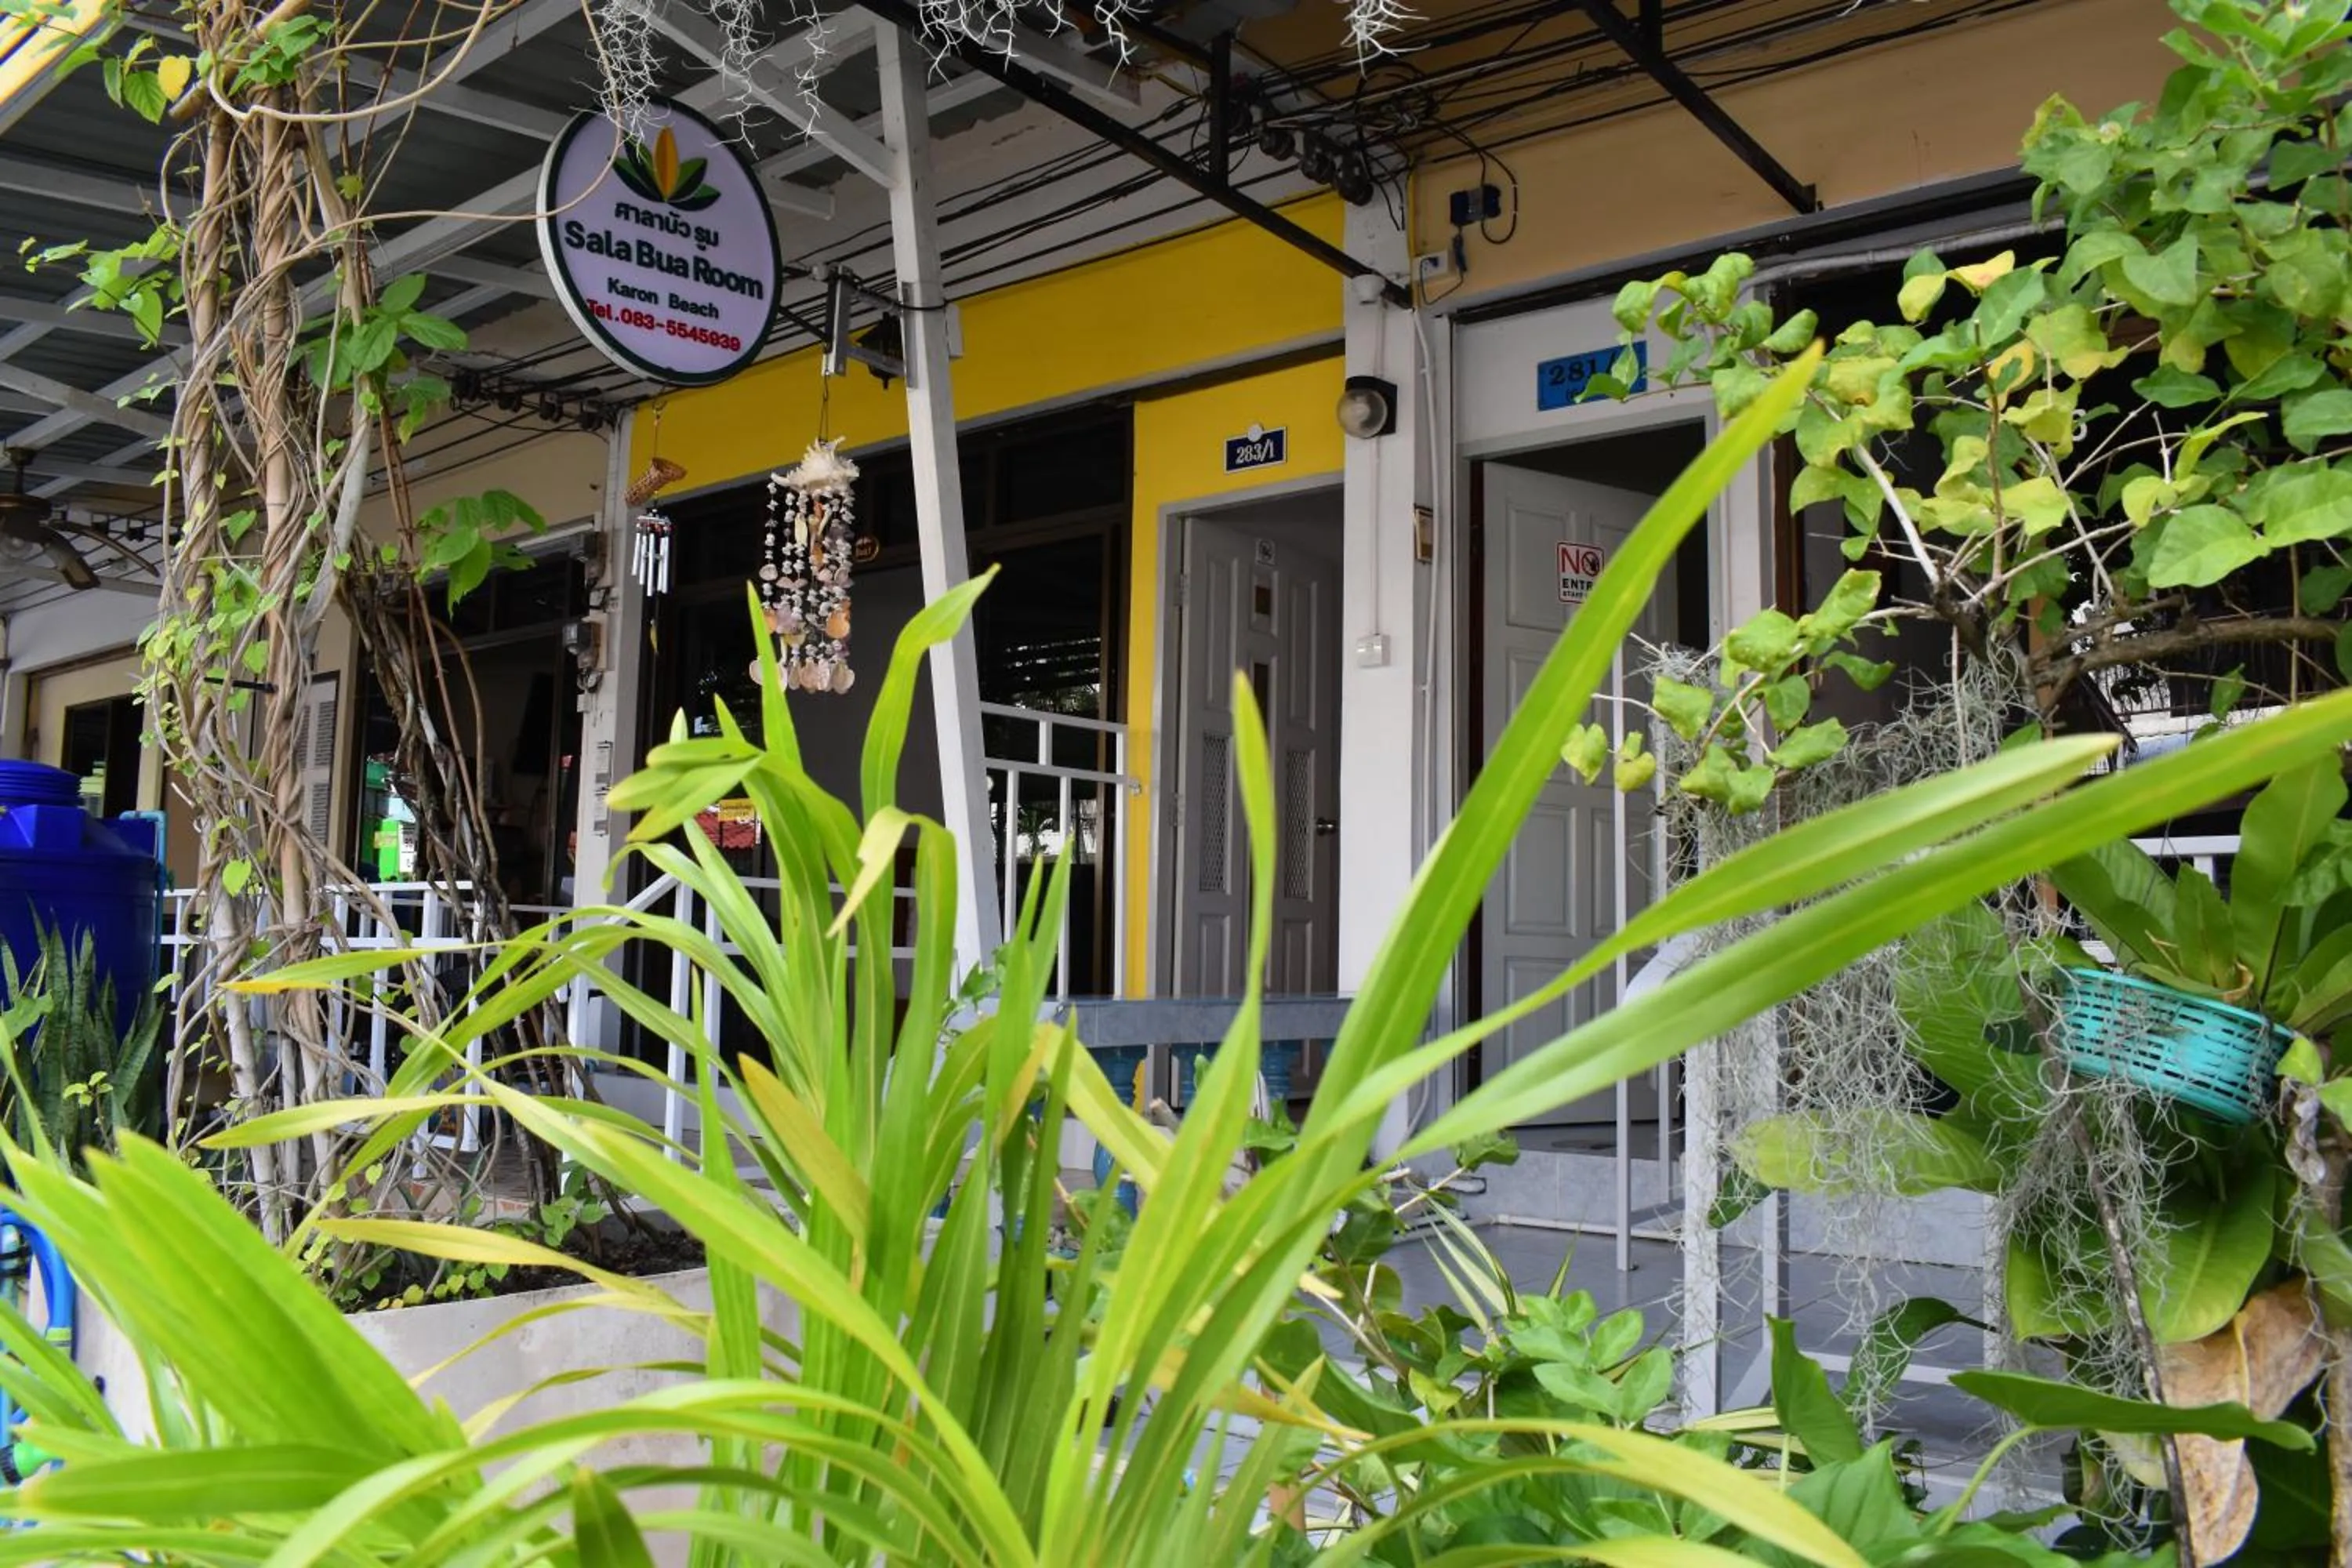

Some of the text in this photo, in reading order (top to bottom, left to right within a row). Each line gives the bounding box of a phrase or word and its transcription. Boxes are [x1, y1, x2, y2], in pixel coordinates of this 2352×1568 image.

[564, 220, 764, 299] Sala Bua Room
[608, 277, 719, 320] Karon Beach
[1236, 438, 1274, 464] 283/1
[1561, 546, 1600, 577] NO
[1563, 578, 1595, 590] ENTR
